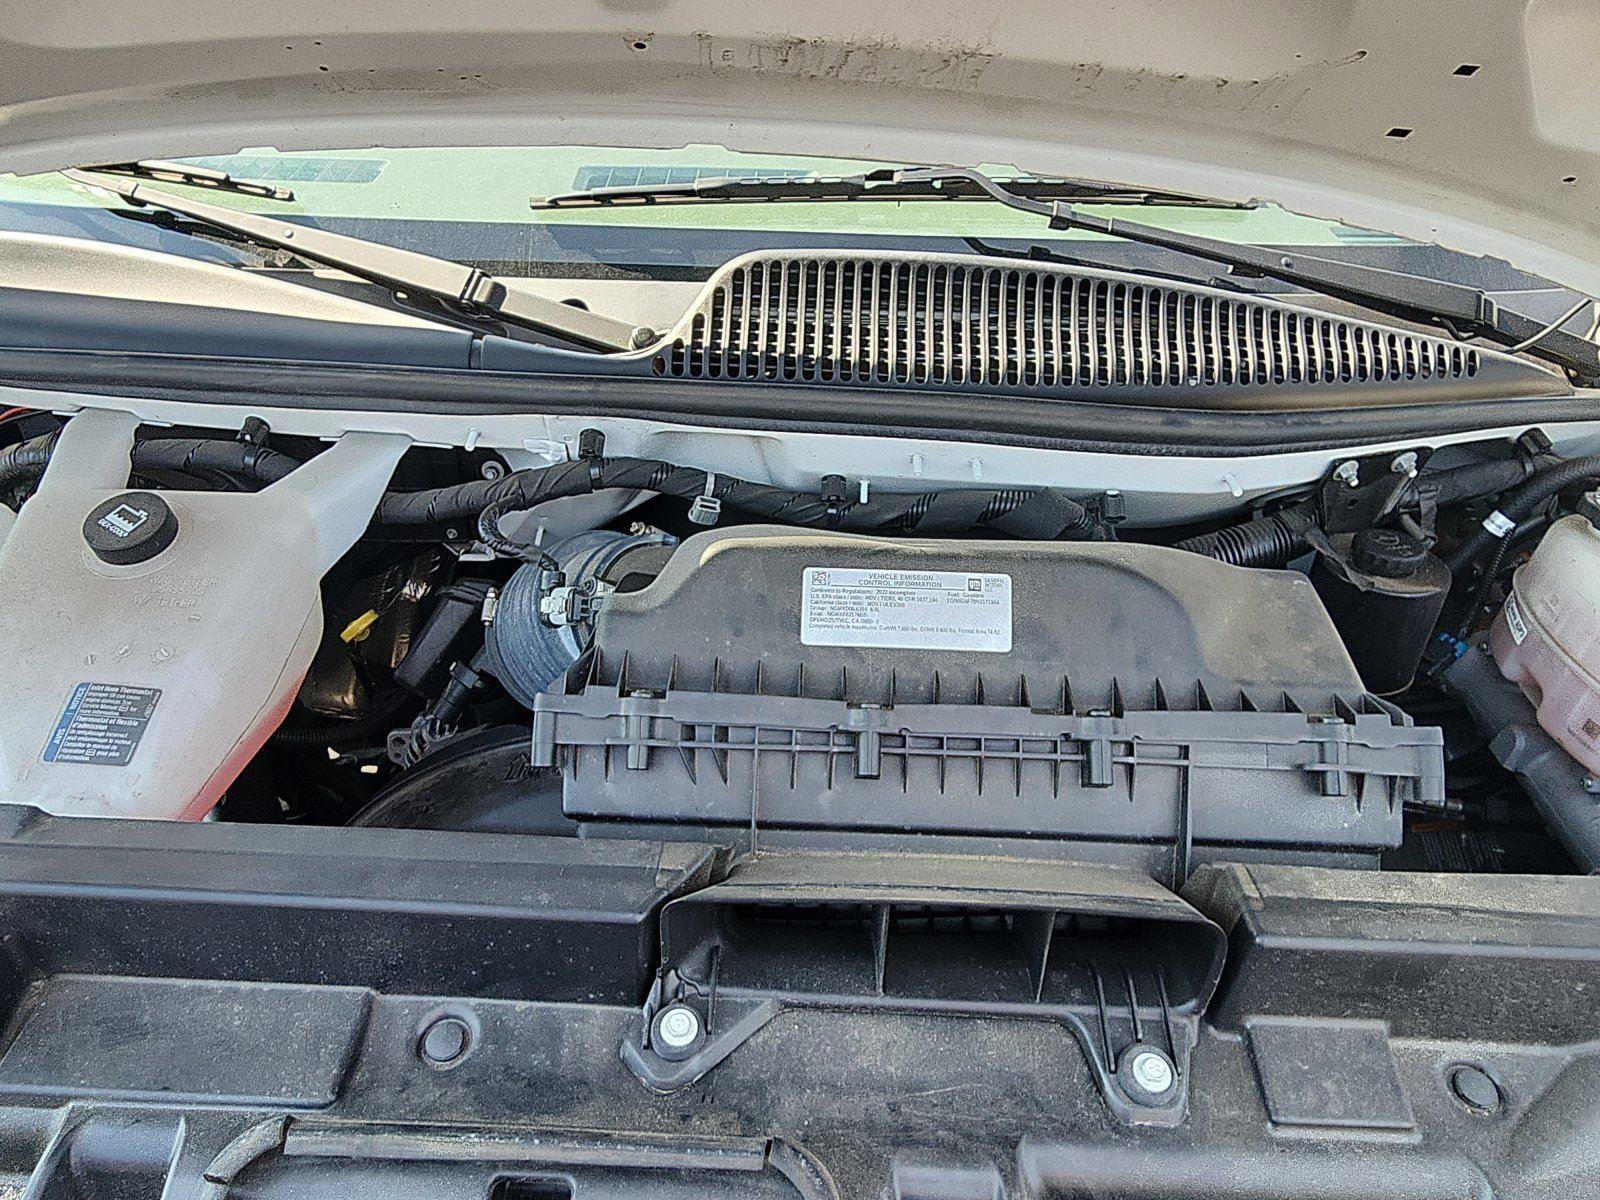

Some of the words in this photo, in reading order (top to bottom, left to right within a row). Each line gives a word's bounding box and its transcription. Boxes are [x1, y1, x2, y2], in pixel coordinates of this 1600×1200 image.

[900, 574, 934, 582] EMISSION
[858, 579, 893, 587] CONTROL
[894, 580, 942, 588] INFORMATION
[120, 687, 153, 696] Thermostat
[53, 728, 67, 744] AVIS
[69, 686, 87, 710] NOTICE
[76, 715, 109, 724] Thermostat
[116, 718, 138, 726] flexible
